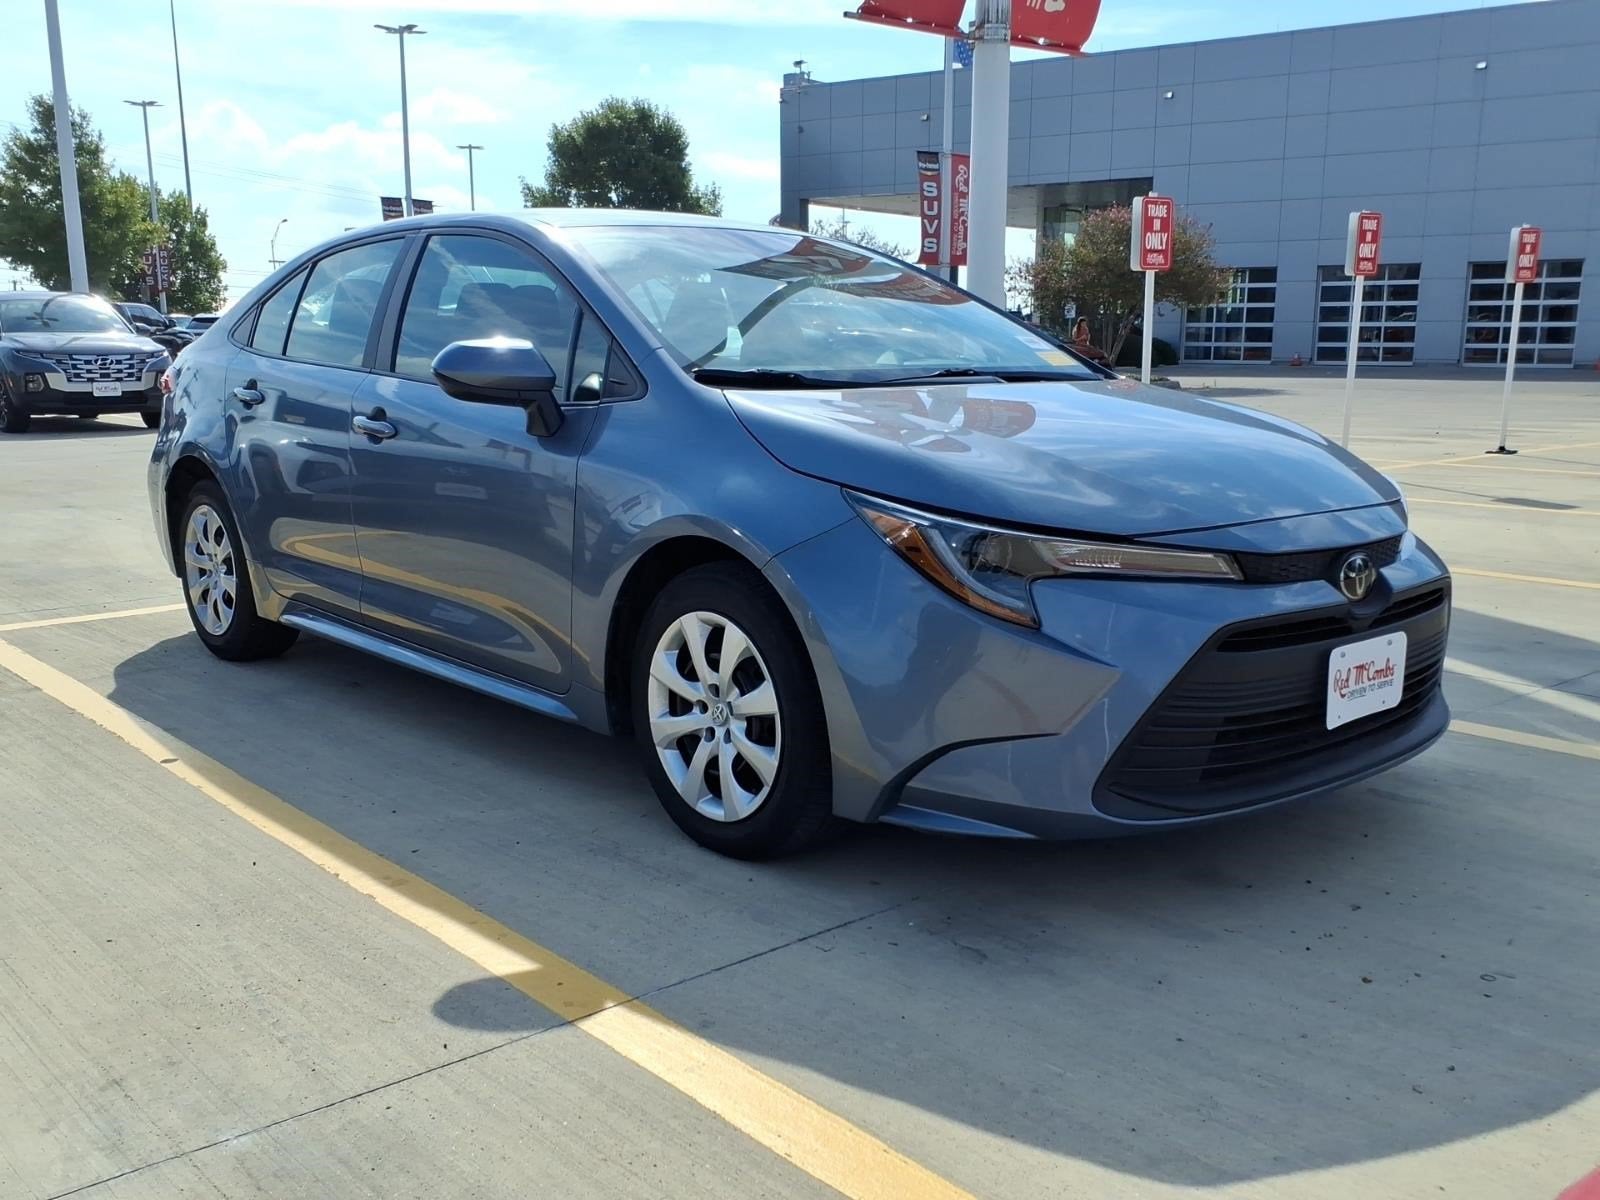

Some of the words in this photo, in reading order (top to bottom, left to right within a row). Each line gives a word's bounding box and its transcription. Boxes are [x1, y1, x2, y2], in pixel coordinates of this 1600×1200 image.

[956, 164, 968, 193] Red
[923, 181, 938, 253] SUVS
[1147, 204, 1168, 217] TRADE
[1153, 218, 1161, 231] IN
[1362, 219, 1378, 230] TRADE
[1145, 232, 1168, 250] ONLY
[1359, 243, 1377, 258] ONLY
[1333, 667, 1352, 699] Red
[1353, 657, 1398, 686] McCombs
[1368, 683, 1377, 692] TO
